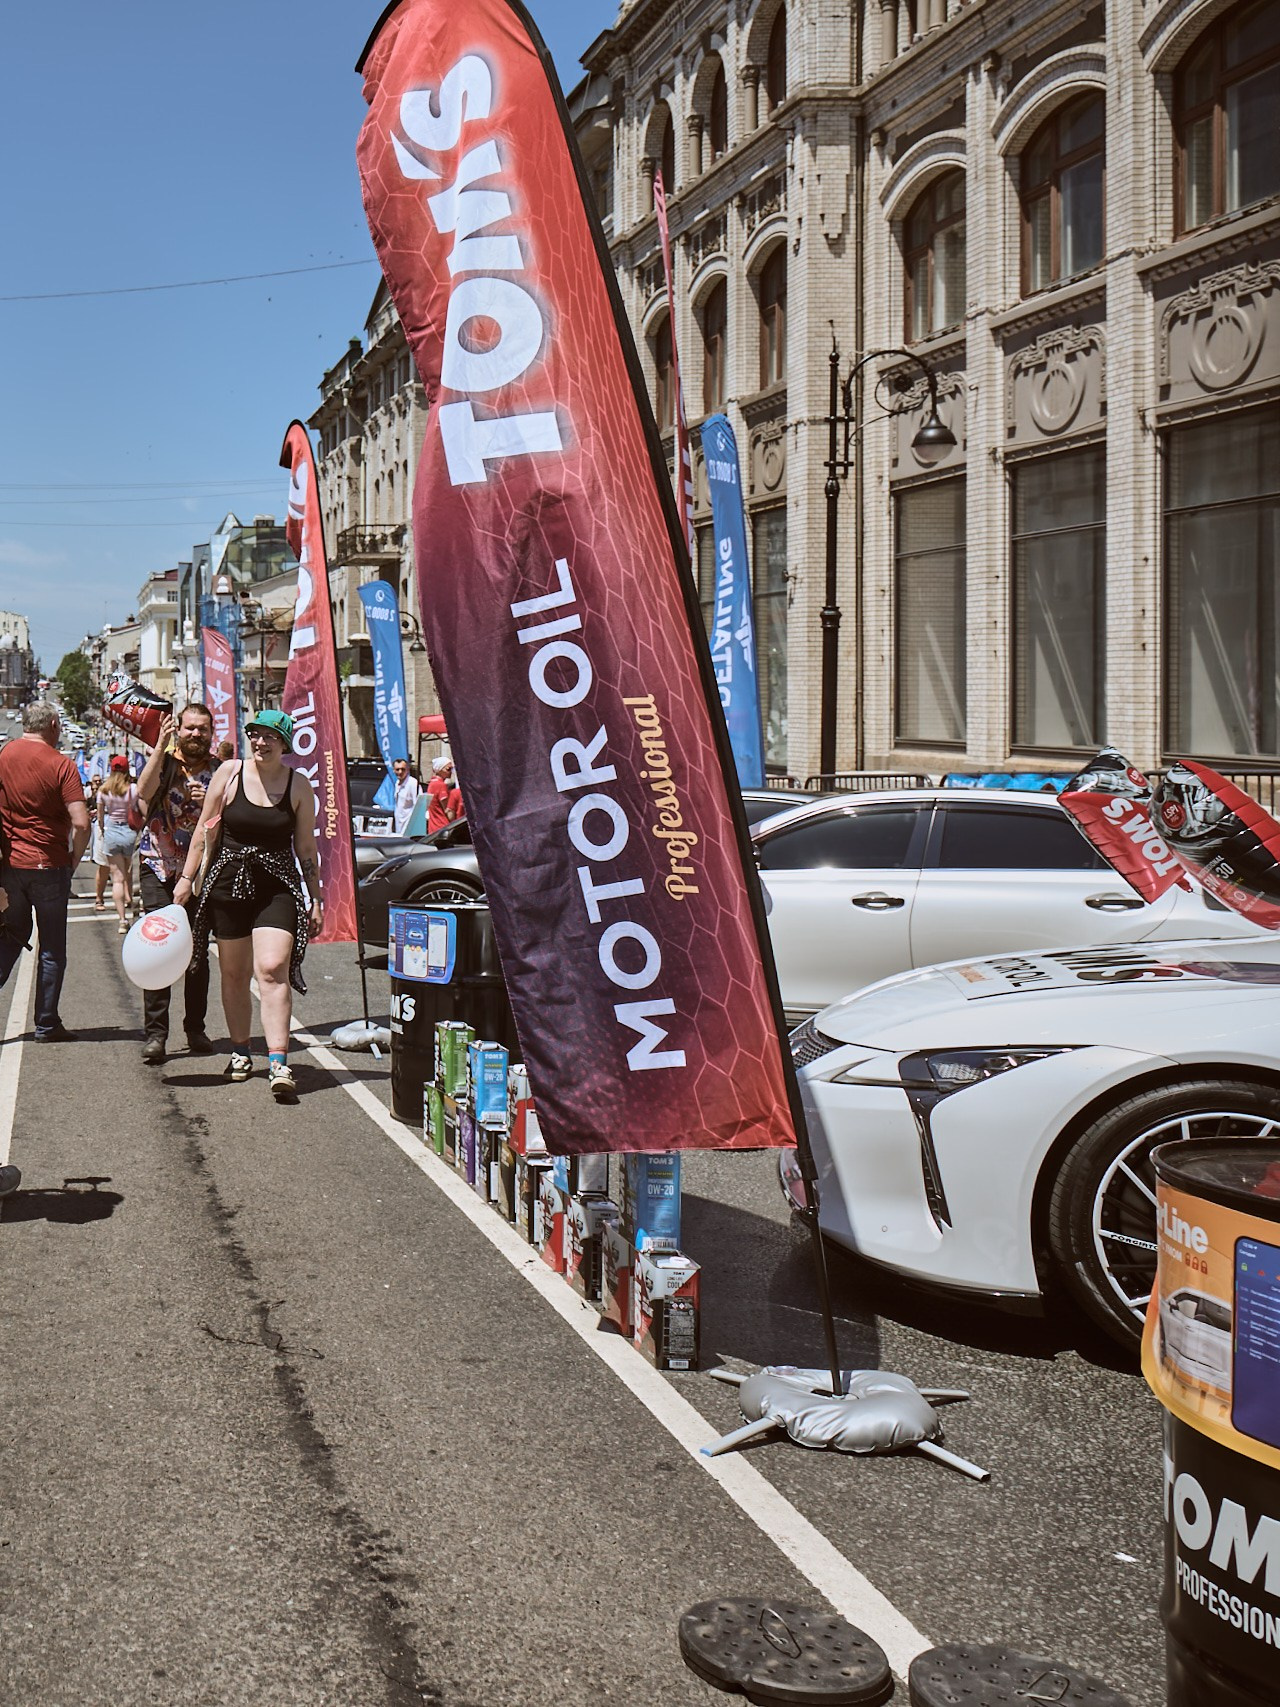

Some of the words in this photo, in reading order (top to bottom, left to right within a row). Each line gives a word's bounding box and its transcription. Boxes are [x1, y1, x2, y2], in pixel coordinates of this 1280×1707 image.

[389, 54, 563, 486] TOM'S
[510, 558, 592, 709] OIL
[292, 691, 317, 757] OIL
[324, 750, 339, 840] Professional
[637, 693, 700, 902] Professional
[1102, 798, 1181, 877] TOM'S
[550, 726, 688, 1072] MOTOR
[391, 993, 416, 1021] M'S
[648, 1184, 674, 1196] 0W-20
